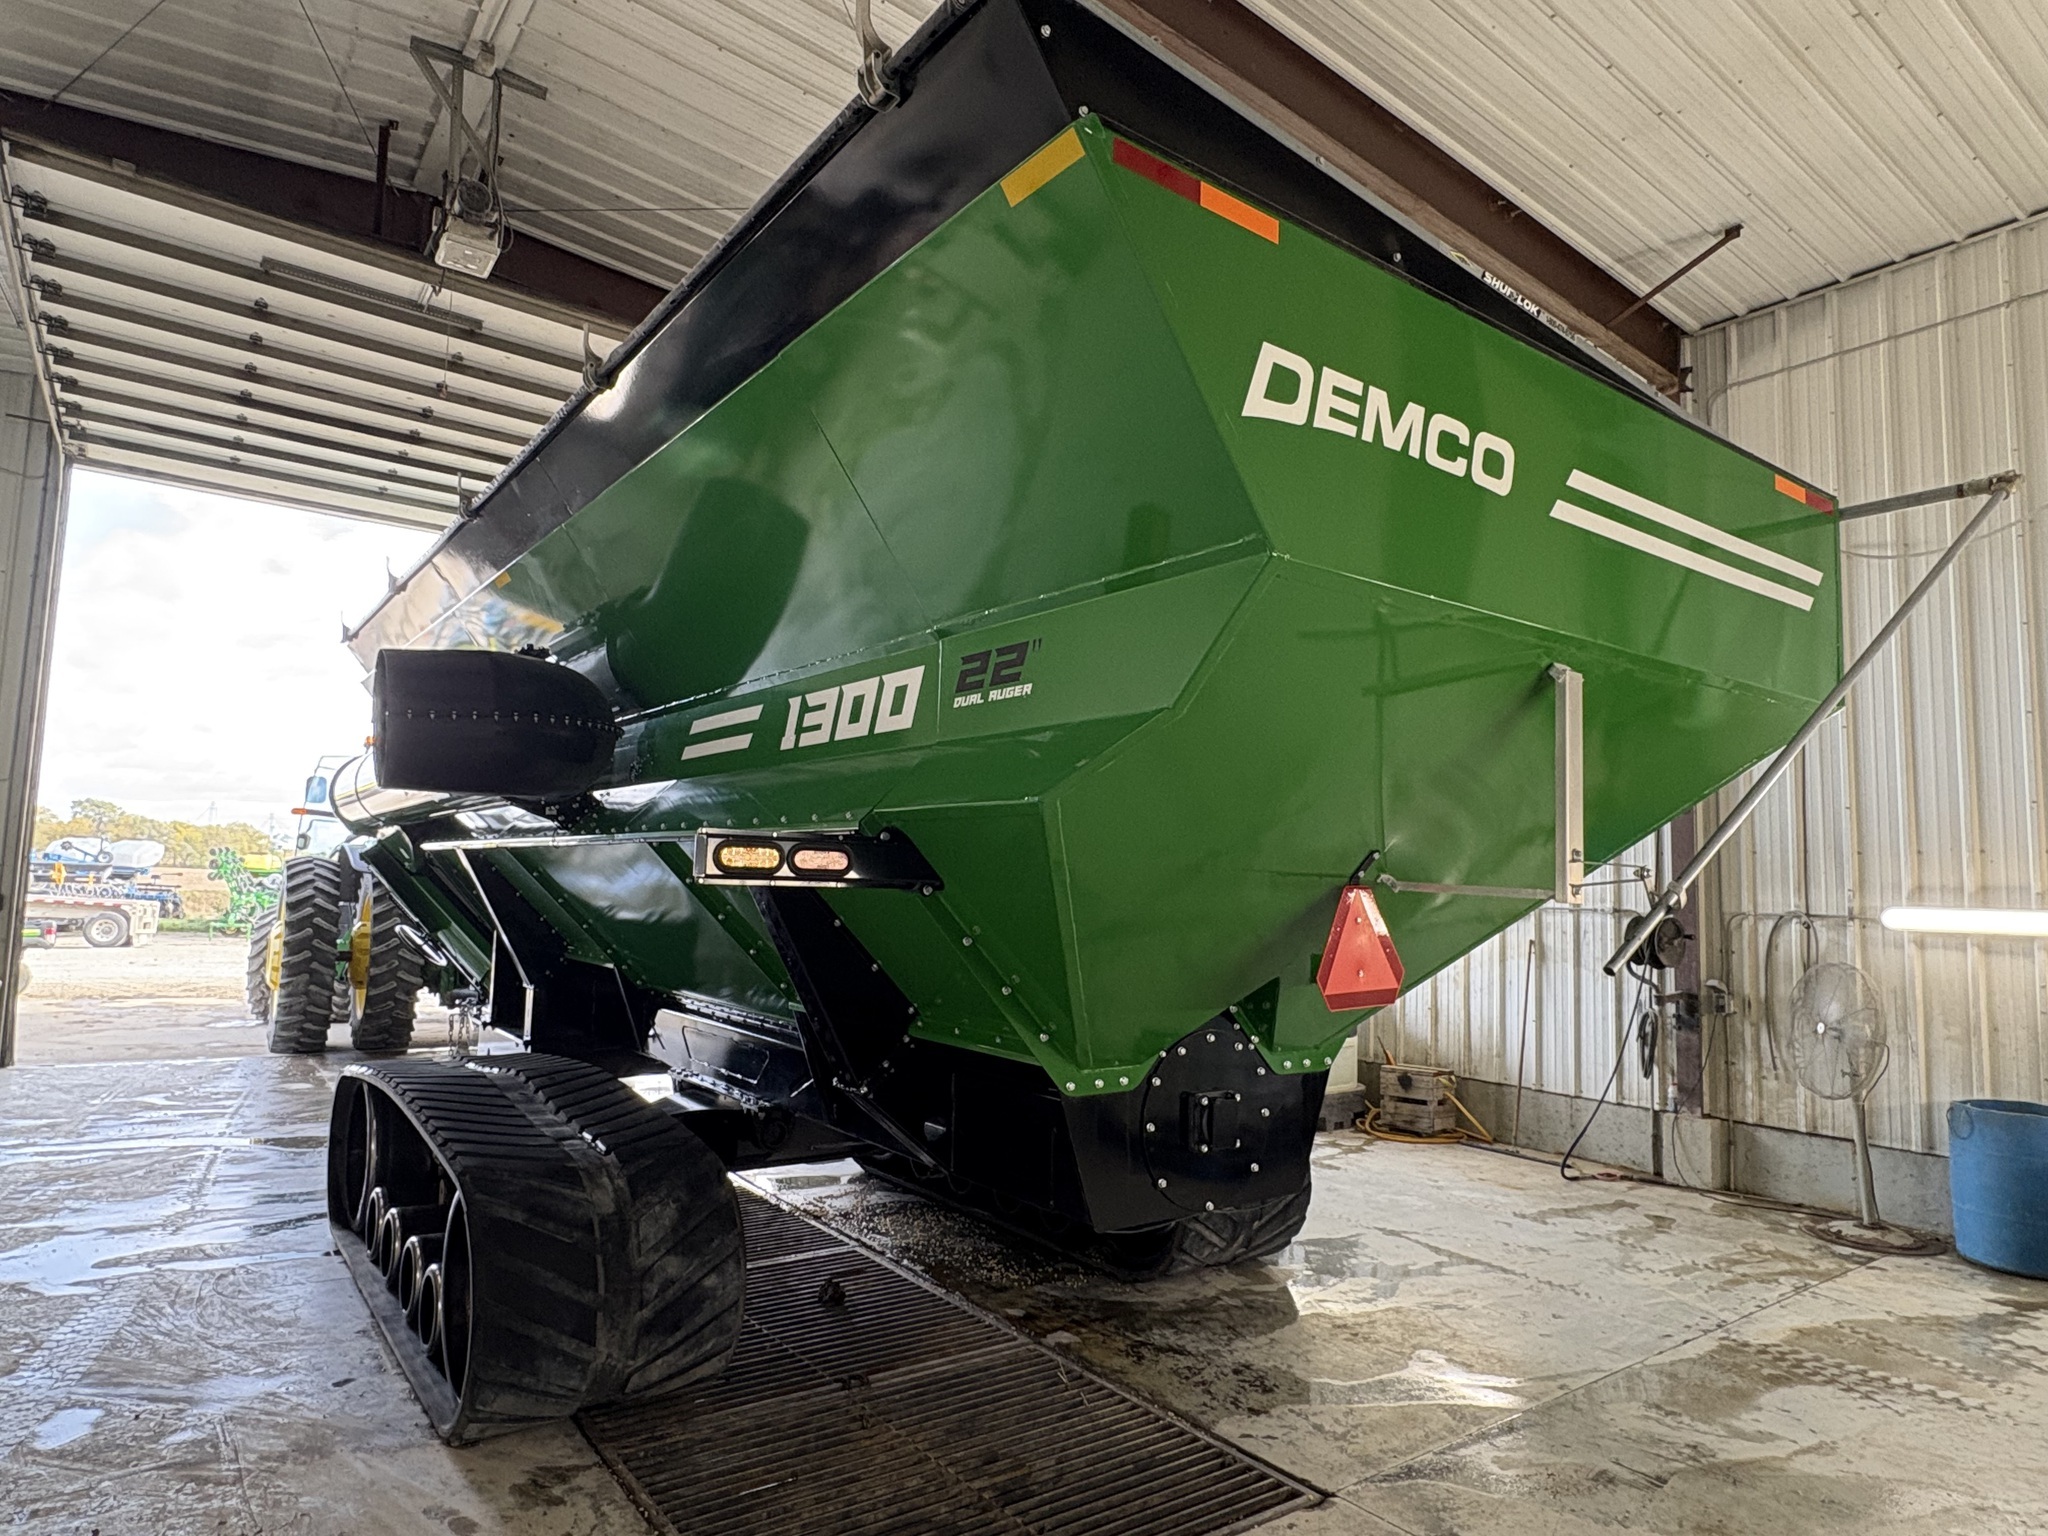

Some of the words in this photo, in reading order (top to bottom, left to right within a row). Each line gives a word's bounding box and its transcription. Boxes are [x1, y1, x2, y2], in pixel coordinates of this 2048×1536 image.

[1241, 341, 1515, 496] DEMCO
[780, 664, 926, 751] 1300
[953, 693, 985, 709] DUAL
[987, 683, 1033, 702] AUGER
